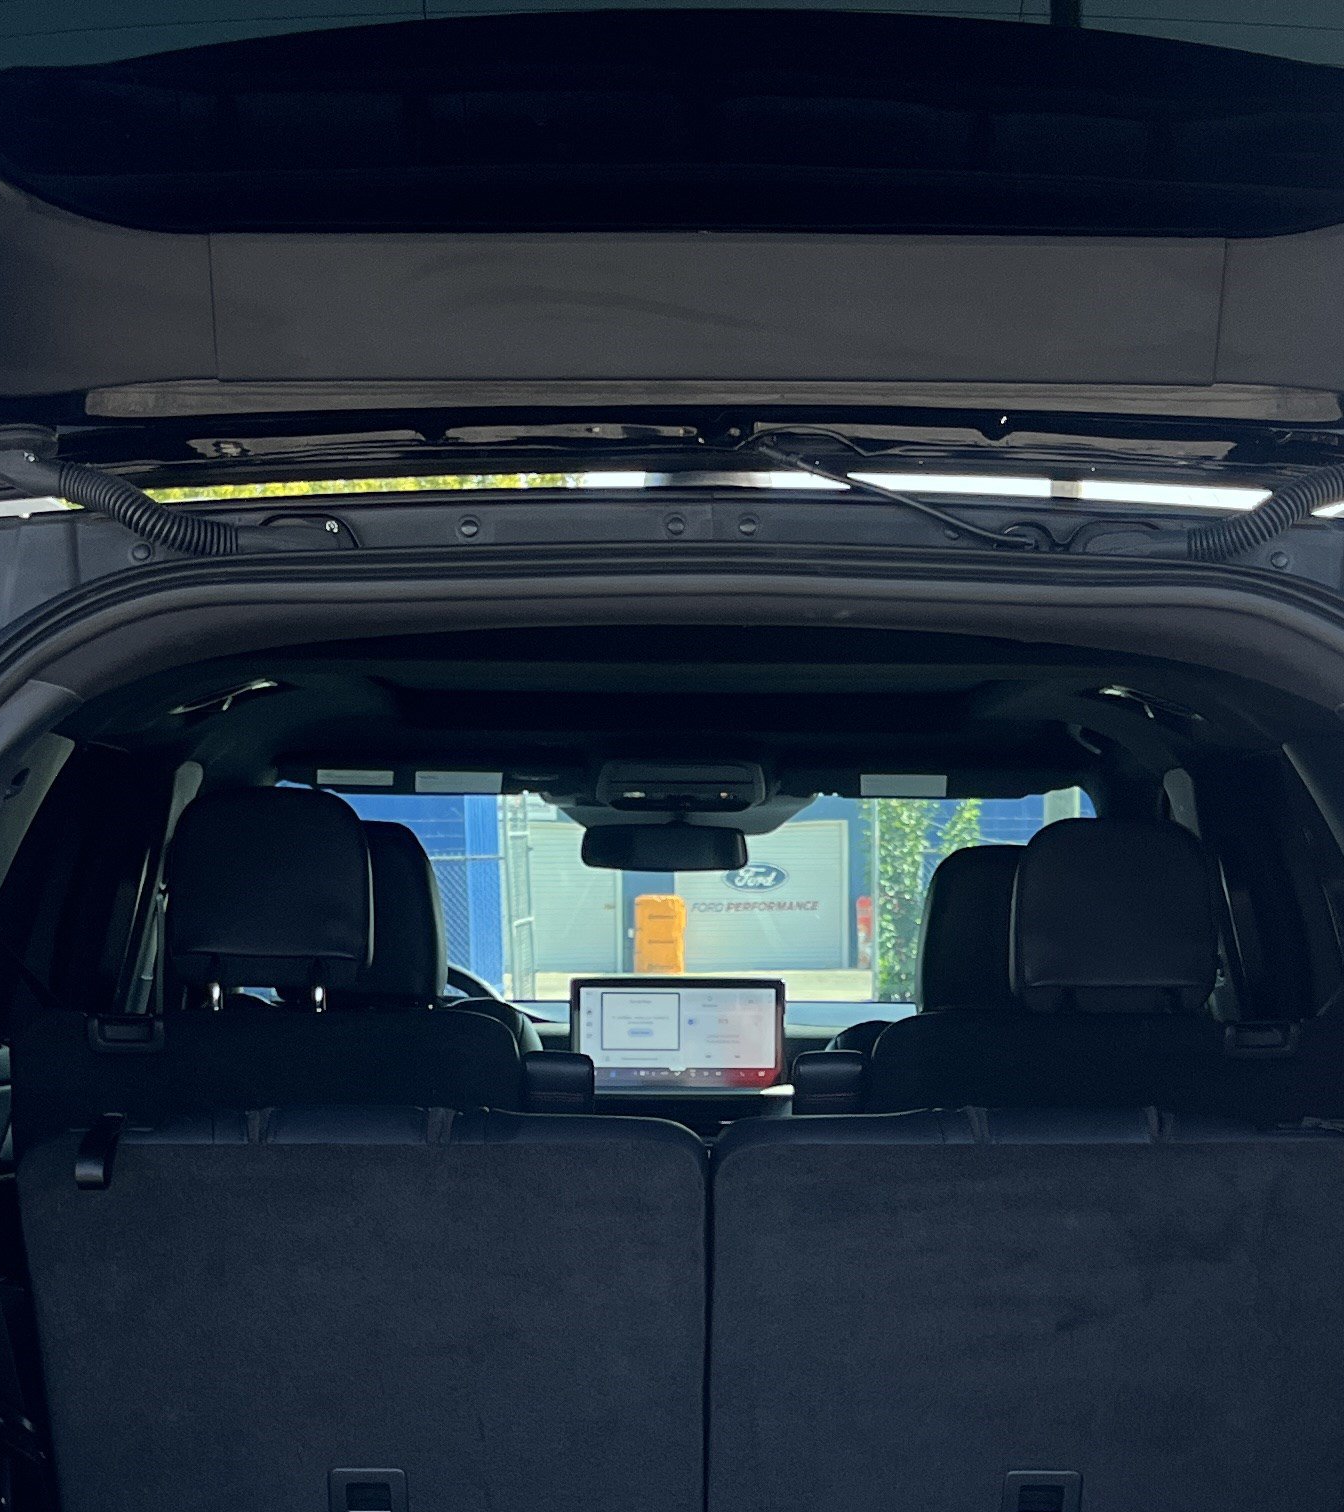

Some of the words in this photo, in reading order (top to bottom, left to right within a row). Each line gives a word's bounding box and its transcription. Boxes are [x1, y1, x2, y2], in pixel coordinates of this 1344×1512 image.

[734, 866, 776, 887] Ford
[690, 902, 724, 913] FORD
[724, 901, 819, 912] PERFORMANCE
